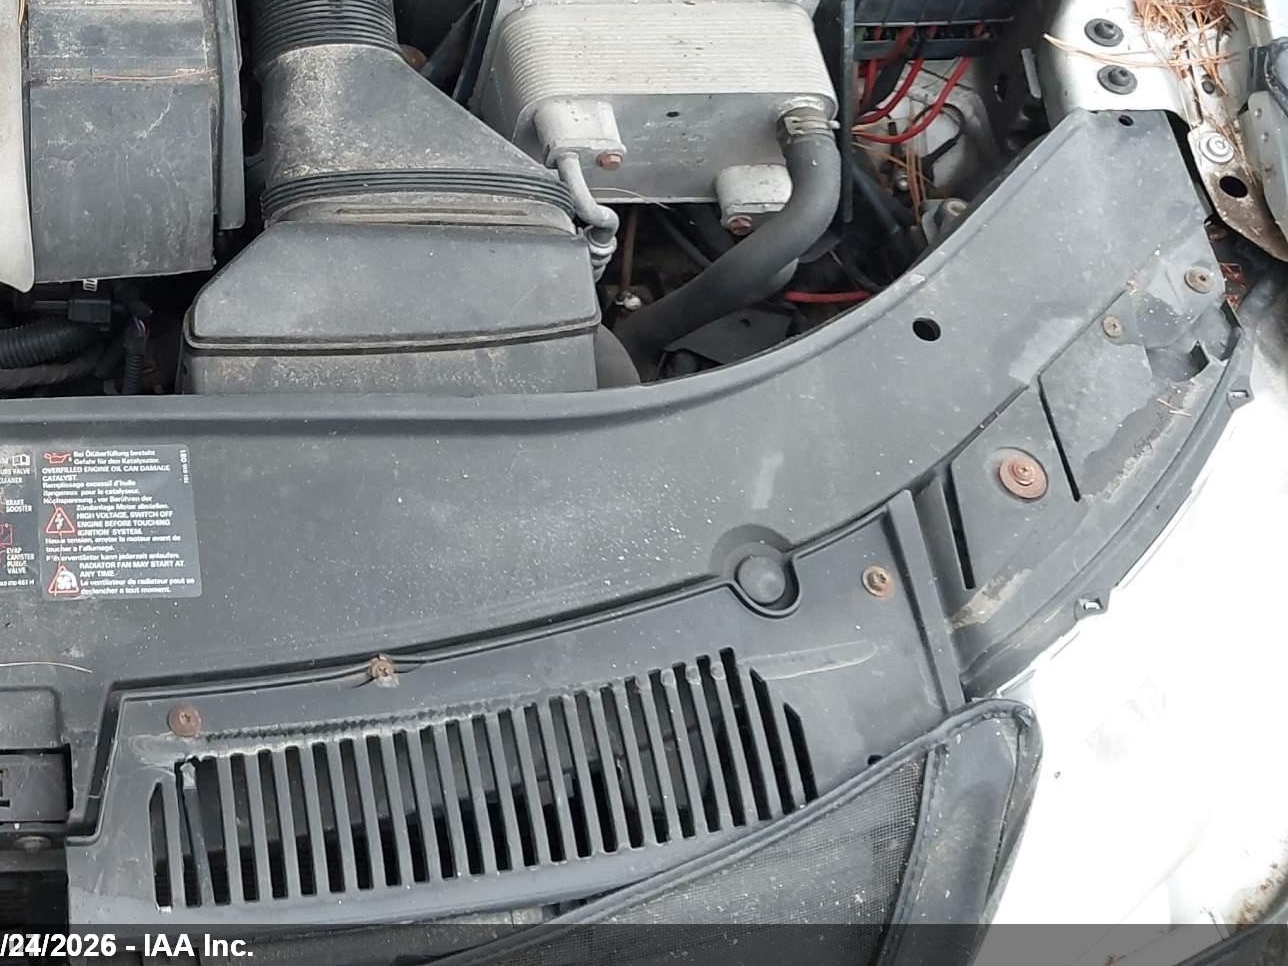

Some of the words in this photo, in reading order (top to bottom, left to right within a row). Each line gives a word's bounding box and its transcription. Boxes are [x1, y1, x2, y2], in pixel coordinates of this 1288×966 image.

[74, 458, 96, 466] Gefahr
[42, 466, 82, 474] OVERFILLED
[76, 512, 95, 520] HIGH
[77, 520, 103, 528] ENGINE
[7, 553, 34, 561] CANISTER
[79, 561, 116, 569] RADIATOR
